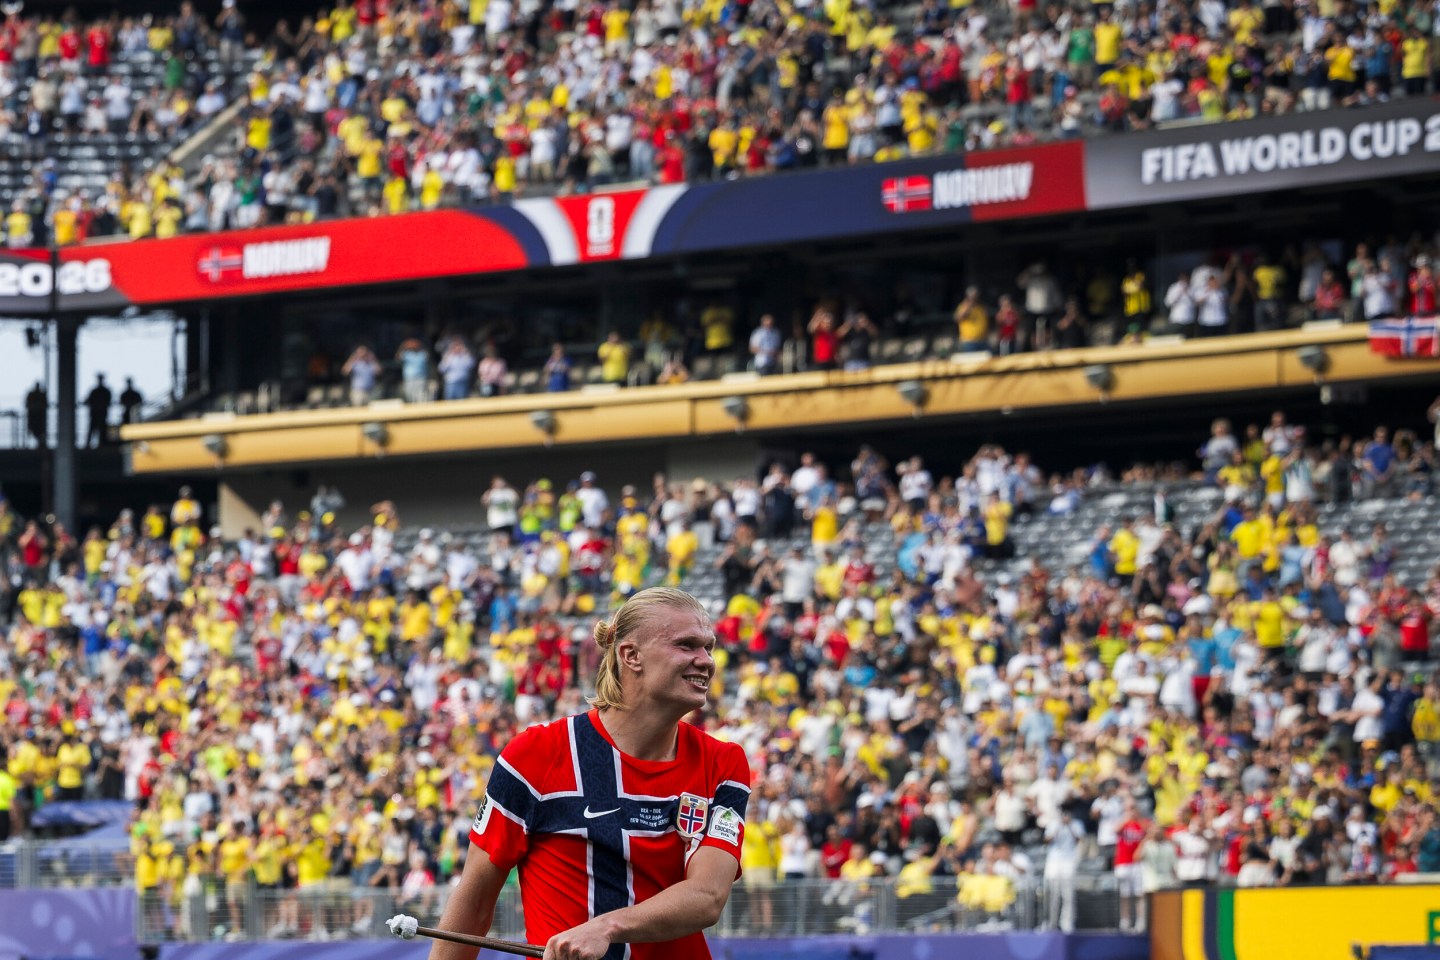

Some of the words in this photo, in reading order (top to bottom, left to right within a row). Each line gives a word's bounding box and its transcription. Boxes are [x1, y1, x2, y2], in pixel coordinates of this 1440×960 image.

[1141, 141, 1218, 185] FIFA
[1220, 127, 1346, 175] WORLD
[1349, 117, 1421, 161] CUP
[714, 824, 737, 837] EDUCATION
